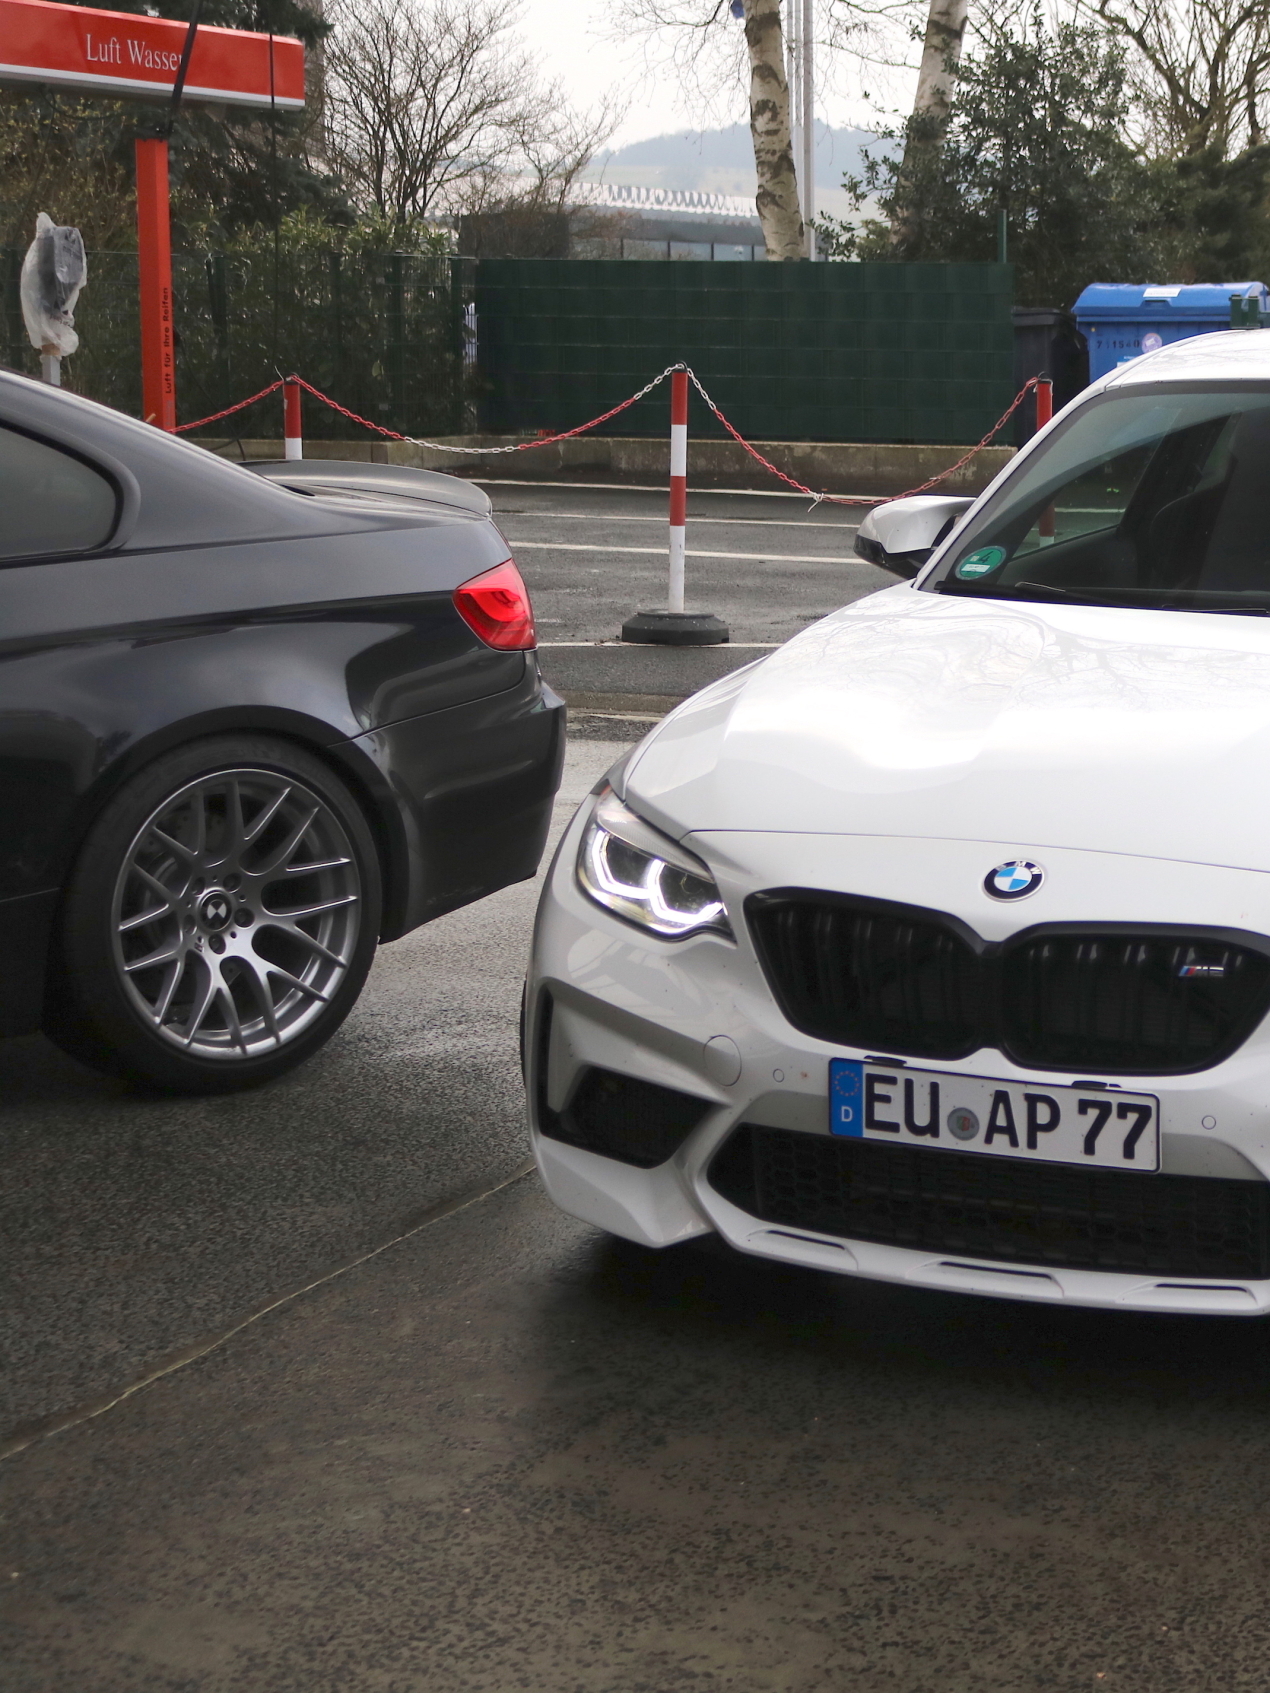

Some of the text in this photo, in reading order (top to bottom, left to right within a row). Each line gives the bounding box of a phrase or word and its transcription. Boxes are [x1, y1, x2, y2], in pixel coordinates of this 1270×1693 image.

[86, 33, 121, 64] Luft
[840, 1105, 853, 1123] D
[864, 1072, 1153, 1160] EU AP 77
